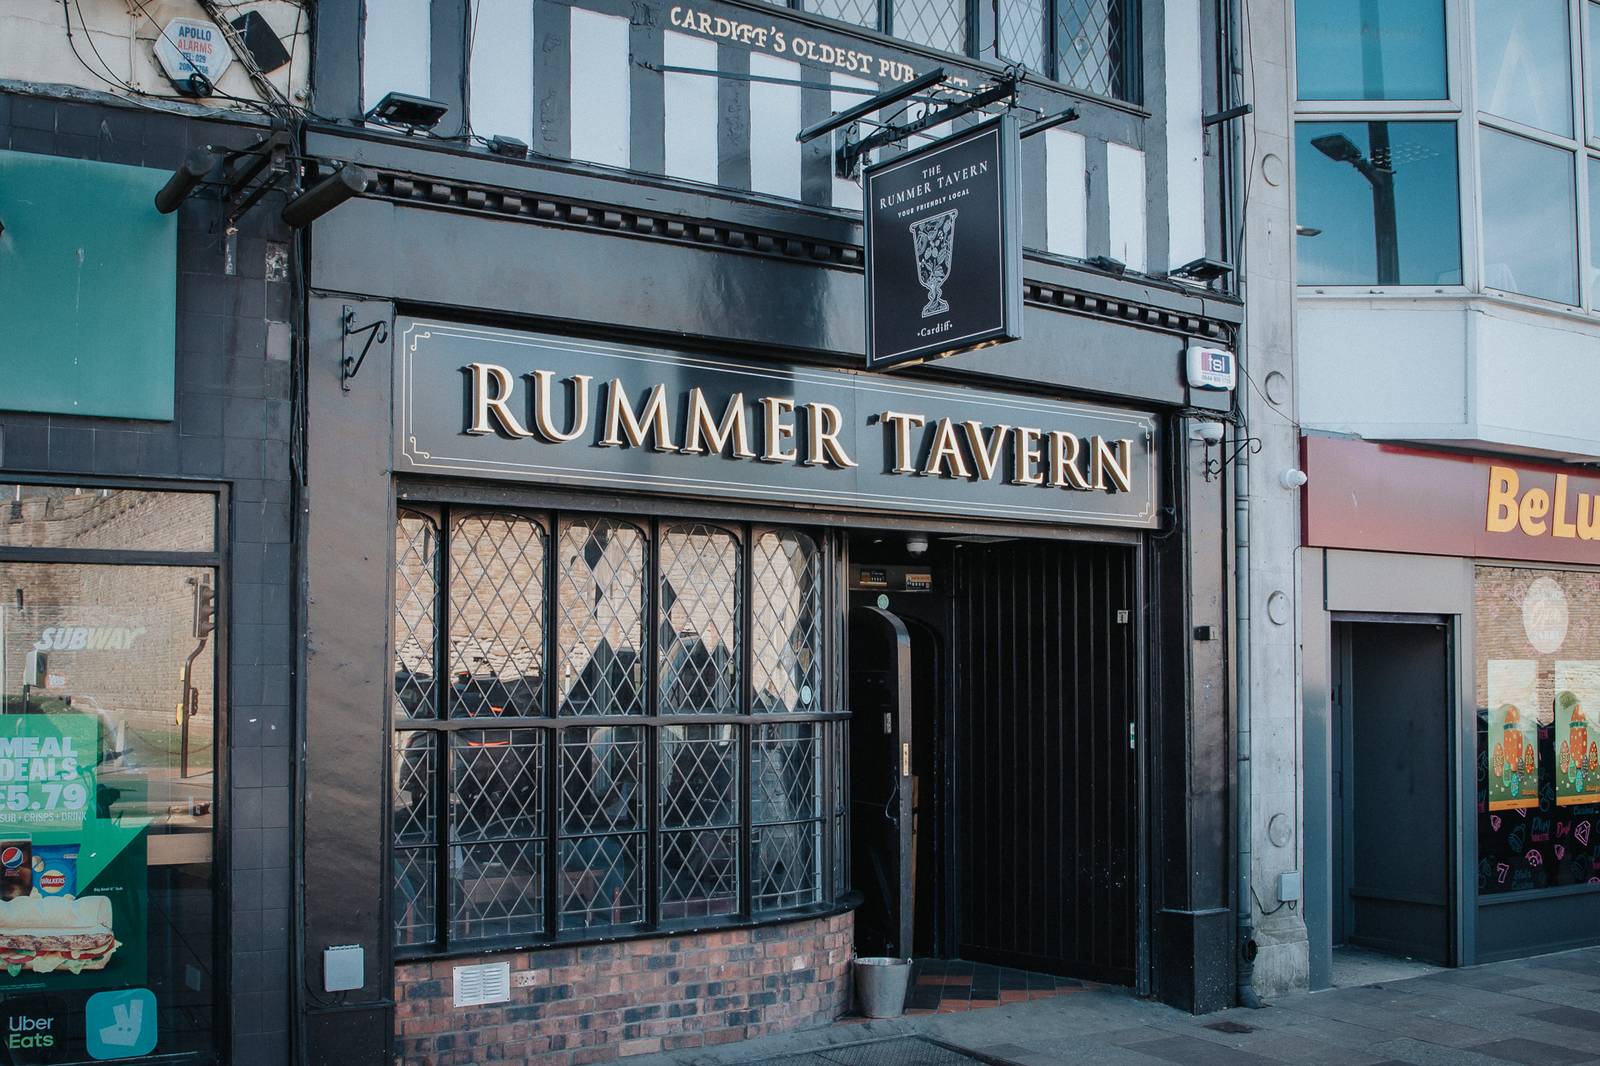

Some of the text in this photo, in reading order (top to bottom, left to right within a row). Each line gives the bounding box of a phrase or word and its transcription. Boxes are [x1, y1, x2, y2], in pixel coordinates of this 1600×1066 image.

[178, 25, 212, 42] APOLLO
[670, 6, 786, 53] CARDIFF'S
[792, 37, 873, 74] OLDEST
[878, 58, 916, 83] PUB
[177, 40, 213, 55] ALARMS
[922, 164, 942, 179] THE
[880, 161, 988, 209] RUMMER TAVERN
[898, 188, 970, 218] YOUR FRIENDLY LOCAL
[465, 362, 1134, 493] RUMMER TAVERN
[33, 626, 148, 650] SUBWAY
[0, 736, 78, 757] MEAL
[0, 757, 78, 782] DEALS
[0, 783, 87, 811] 5.79
[23, 811, 54, 822] CRISPS
[61, 810, 87, 821] DRINK
[9, 1016, 54, 1032] Uber
[9, 1033, 54, 1049] Eats
